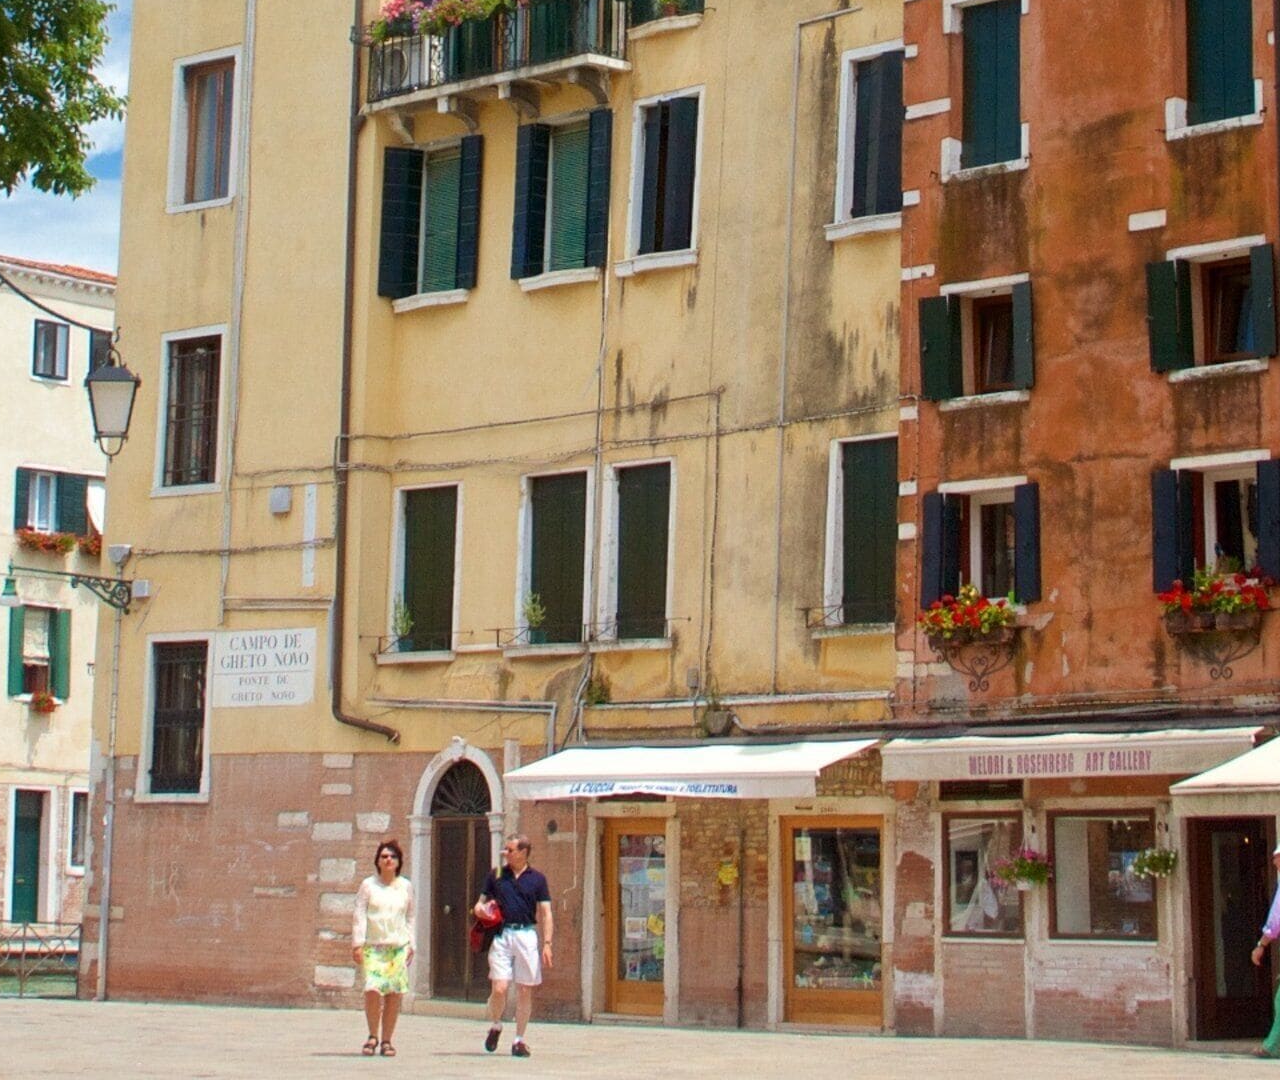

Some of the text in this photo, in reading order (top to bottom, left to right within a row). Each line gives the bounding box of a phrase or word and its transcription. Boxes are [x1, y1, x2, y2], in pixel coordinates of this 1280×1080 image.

[230, 633, 302, 651] CAMPO DE
[221, 652, 309, 669] GHETO NOVO
[277, 675, 289, 685] DE
[272, 691, 295, 700] NOVO
[968, 750, 1151, 776] MELORI & ROSENBERG ART GALLERY
[570, 783, 582, 794] LA
